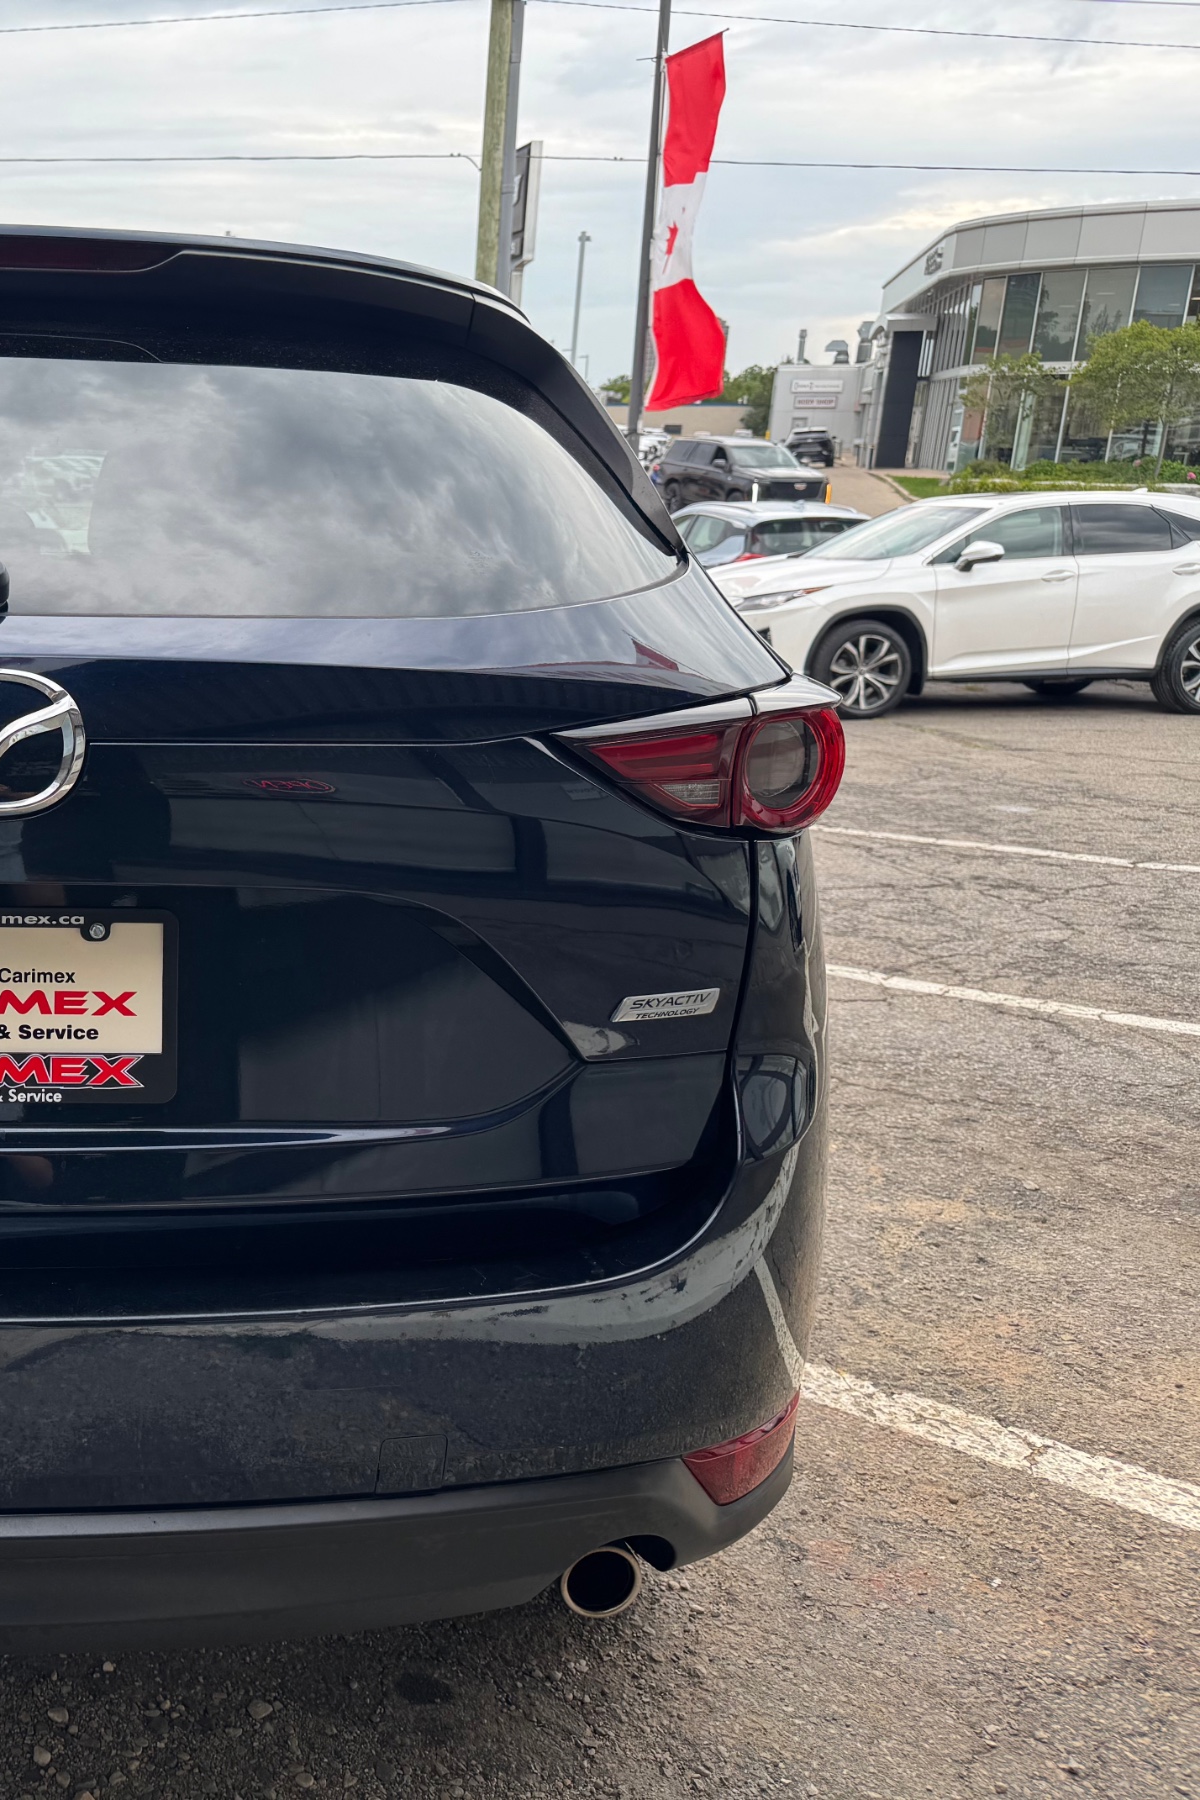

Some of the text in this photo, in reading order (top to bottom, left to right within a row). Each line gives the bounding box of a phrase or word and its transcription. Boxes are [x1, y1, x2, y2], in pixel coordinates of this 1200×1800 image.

[630, 992, 711, 1010] SKYACTIV
[635, 1007, 701, 1019] TECHNOLOGY
[18, 1025, 99, 1041] Service
[8, 1089, 62, 1104] Service
